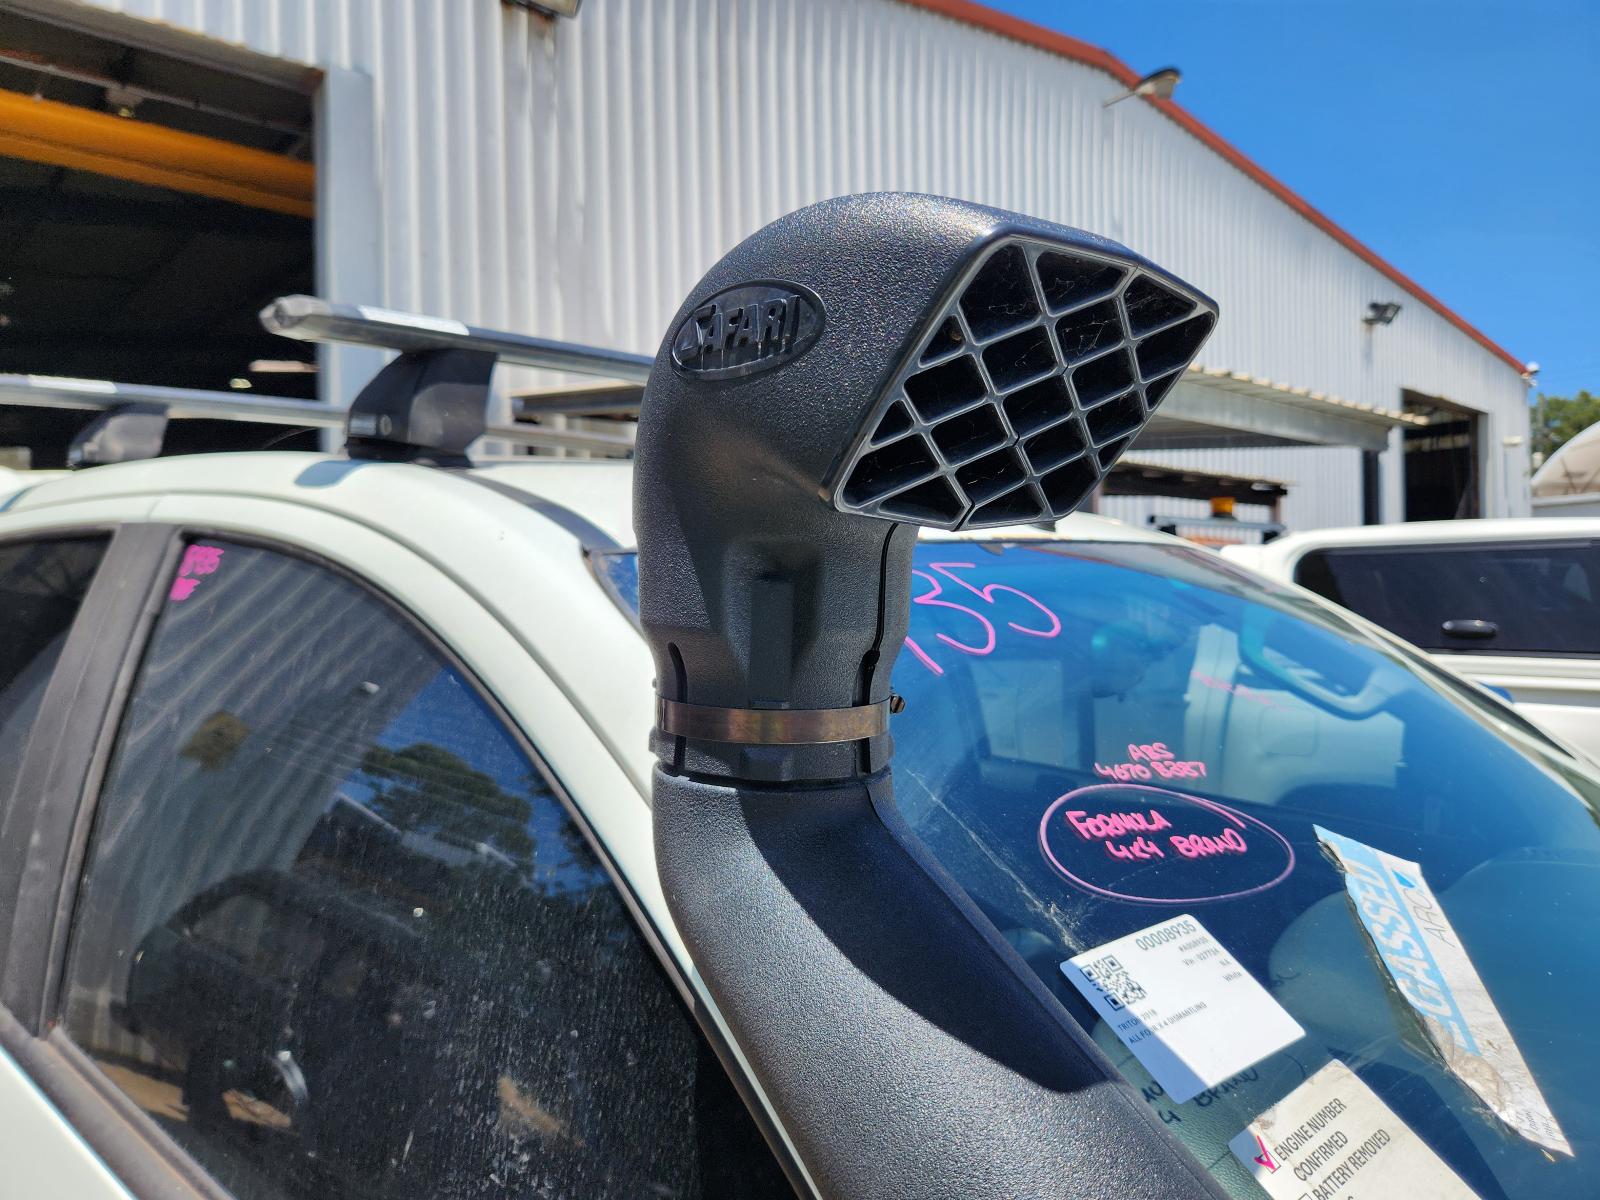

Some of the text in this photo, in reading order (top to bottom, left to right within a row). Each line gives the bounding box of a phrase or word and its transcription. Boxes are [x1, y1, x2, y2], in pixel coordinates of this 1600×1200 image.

[675, 295, 801, 361] SAFARI
[904, 562, 1062, 674] 35
[1094, 762, 1152, 782] 4670
[1127, 742, 1175, 762] ABS
[1135, 919, 1197, 952] 00008935
[1274, 1097, 1348, 1161] ENGINE NUMBER
[1292, 1130, 1350, 1182] CONFIRMED
[1312, 1128, 1392, 1200] BATTERY REMOVED
